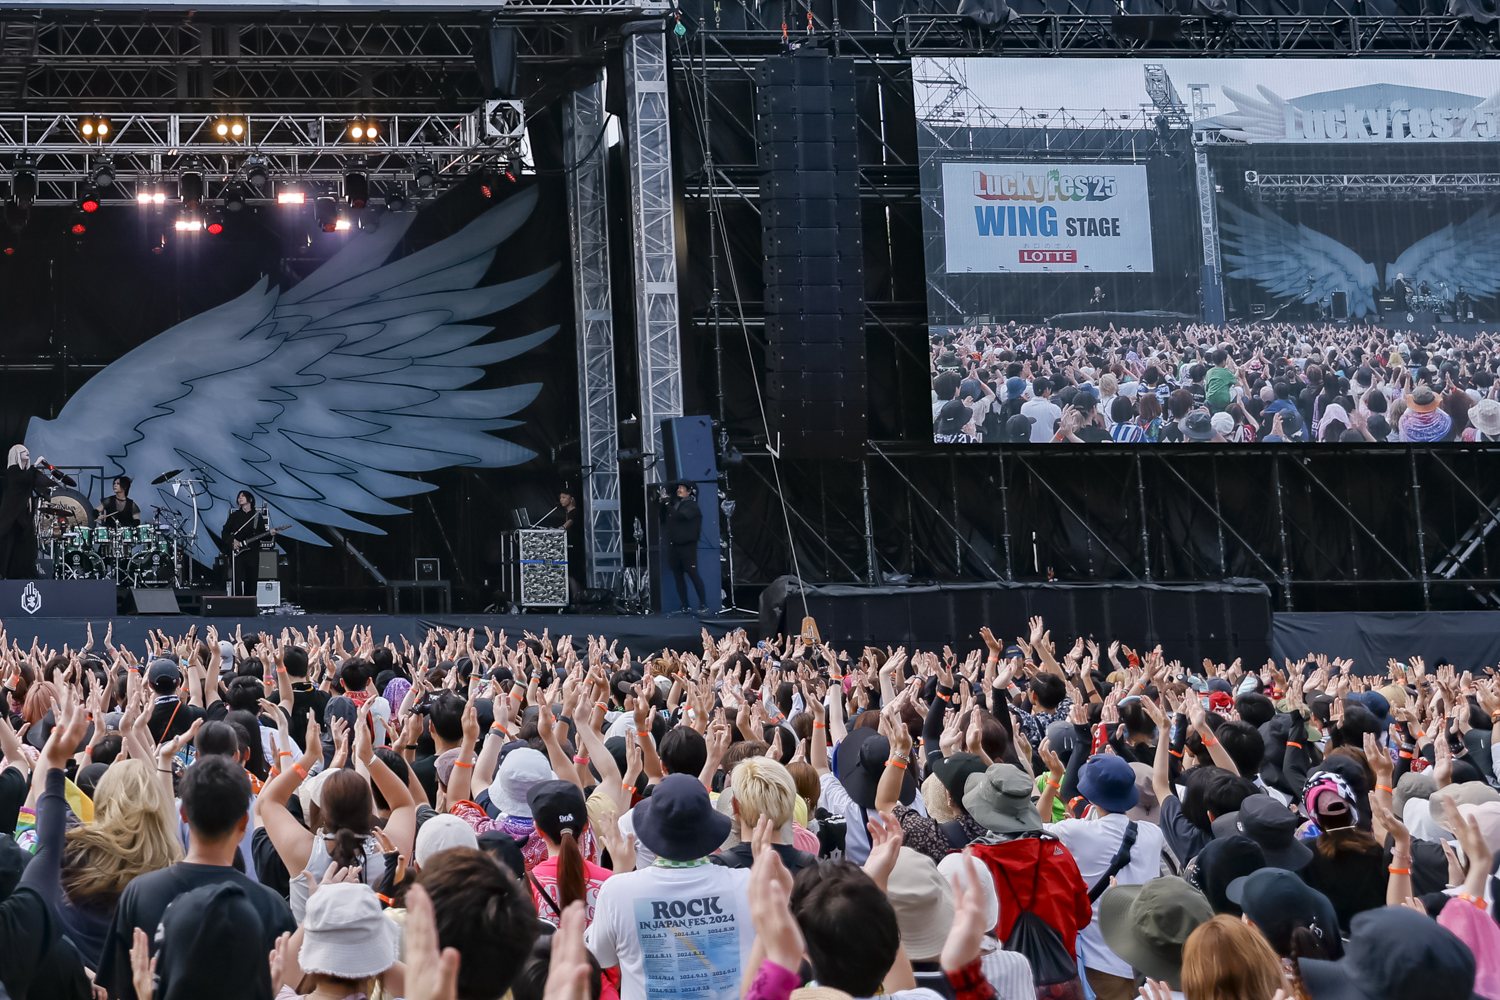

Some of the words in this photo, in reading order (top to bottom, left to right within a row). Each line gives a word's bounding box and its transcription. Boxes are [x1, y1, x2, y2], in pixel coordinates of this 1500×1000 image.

[974, 205, 1059, 237] WING
[1065, 217, 1121, 237] STAGE
[1023, 251, 1073, 262] LOTTE
[651, 896, 723, 919] ROCK
[639, 921, 656, 931] IN
[653, 918, 692, 930] JAPAN
